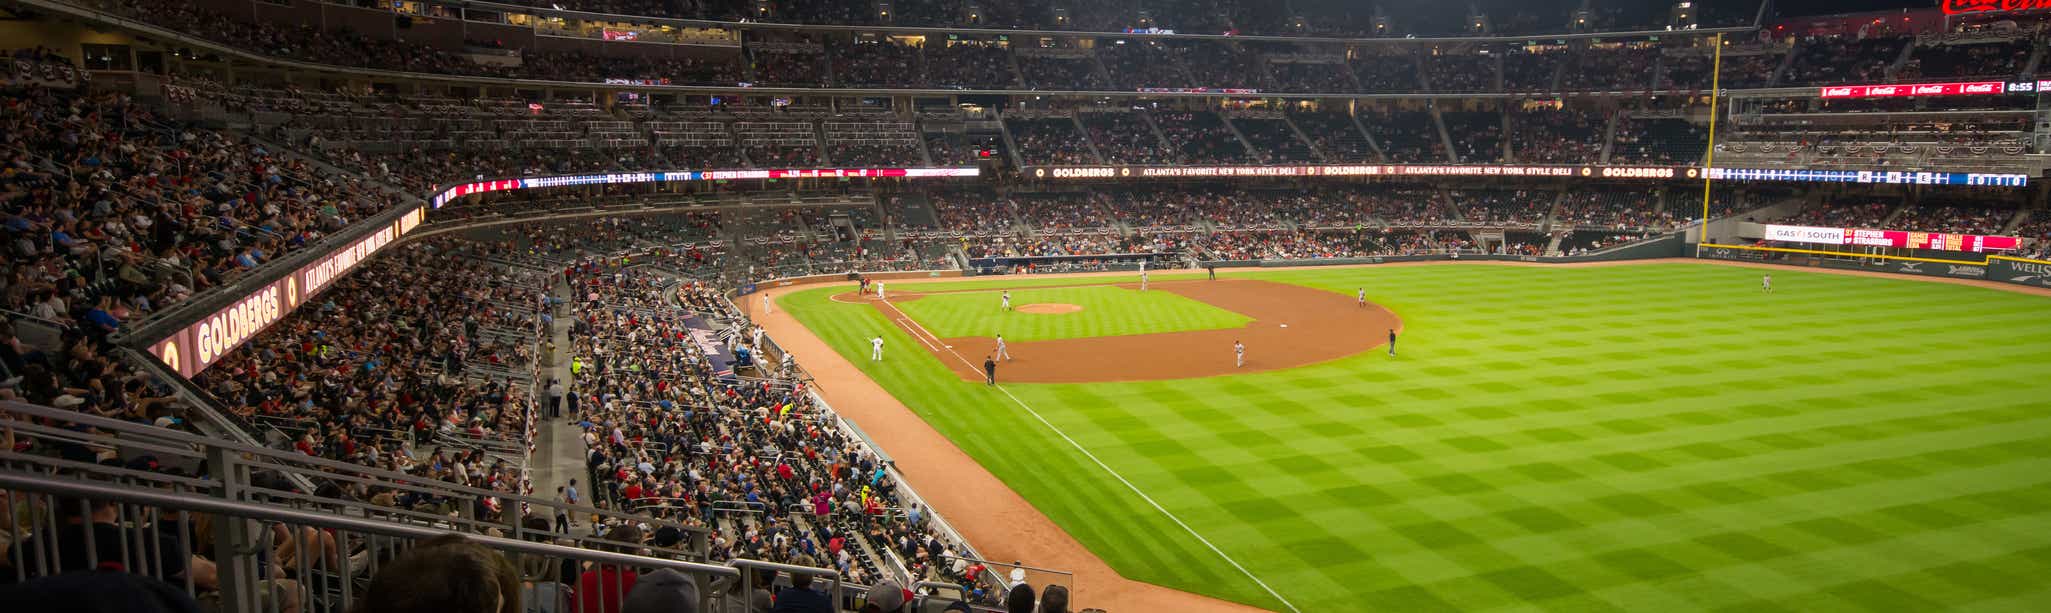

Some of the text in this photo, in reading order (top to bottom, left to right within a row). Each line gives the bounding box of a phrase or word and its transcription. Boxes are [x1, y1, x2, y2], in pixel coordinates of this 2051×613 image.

[2008, 82, 2033, 92] 8:55
[1053, 168, 1115, 177] GOLDBERGS
[1143, 168, 1181, 176] ATLANTA'S
[1182, 167, 1218, 176] FAVORITE
[1218, 167, 1235, 176] NEW
[1236, 167, 1256, 176] YORK
[1256, 167, 1278, 176] STYLE
[1324, 166, 1378, 175] GOLDBERGS
[1405, 167, 1572, 176] ATLANTA'S FAVORITE NEW YORK STYLE DELI
[1602, 167, 1674, 177] GOLDBERGS
[1776, 229, 1796, 238] GAS
[1807, 231, 1840, 240] SOUTH
[1854, 229, 1885, 238] STEPHEN
[1852, 237, 1893, 246] STRASBURG
[2011, 261, 2051, 277] WELLS
[305, 258, 335, 295] ATLANTA'S
[197, 286, 279, 364] GOLDBERGS
